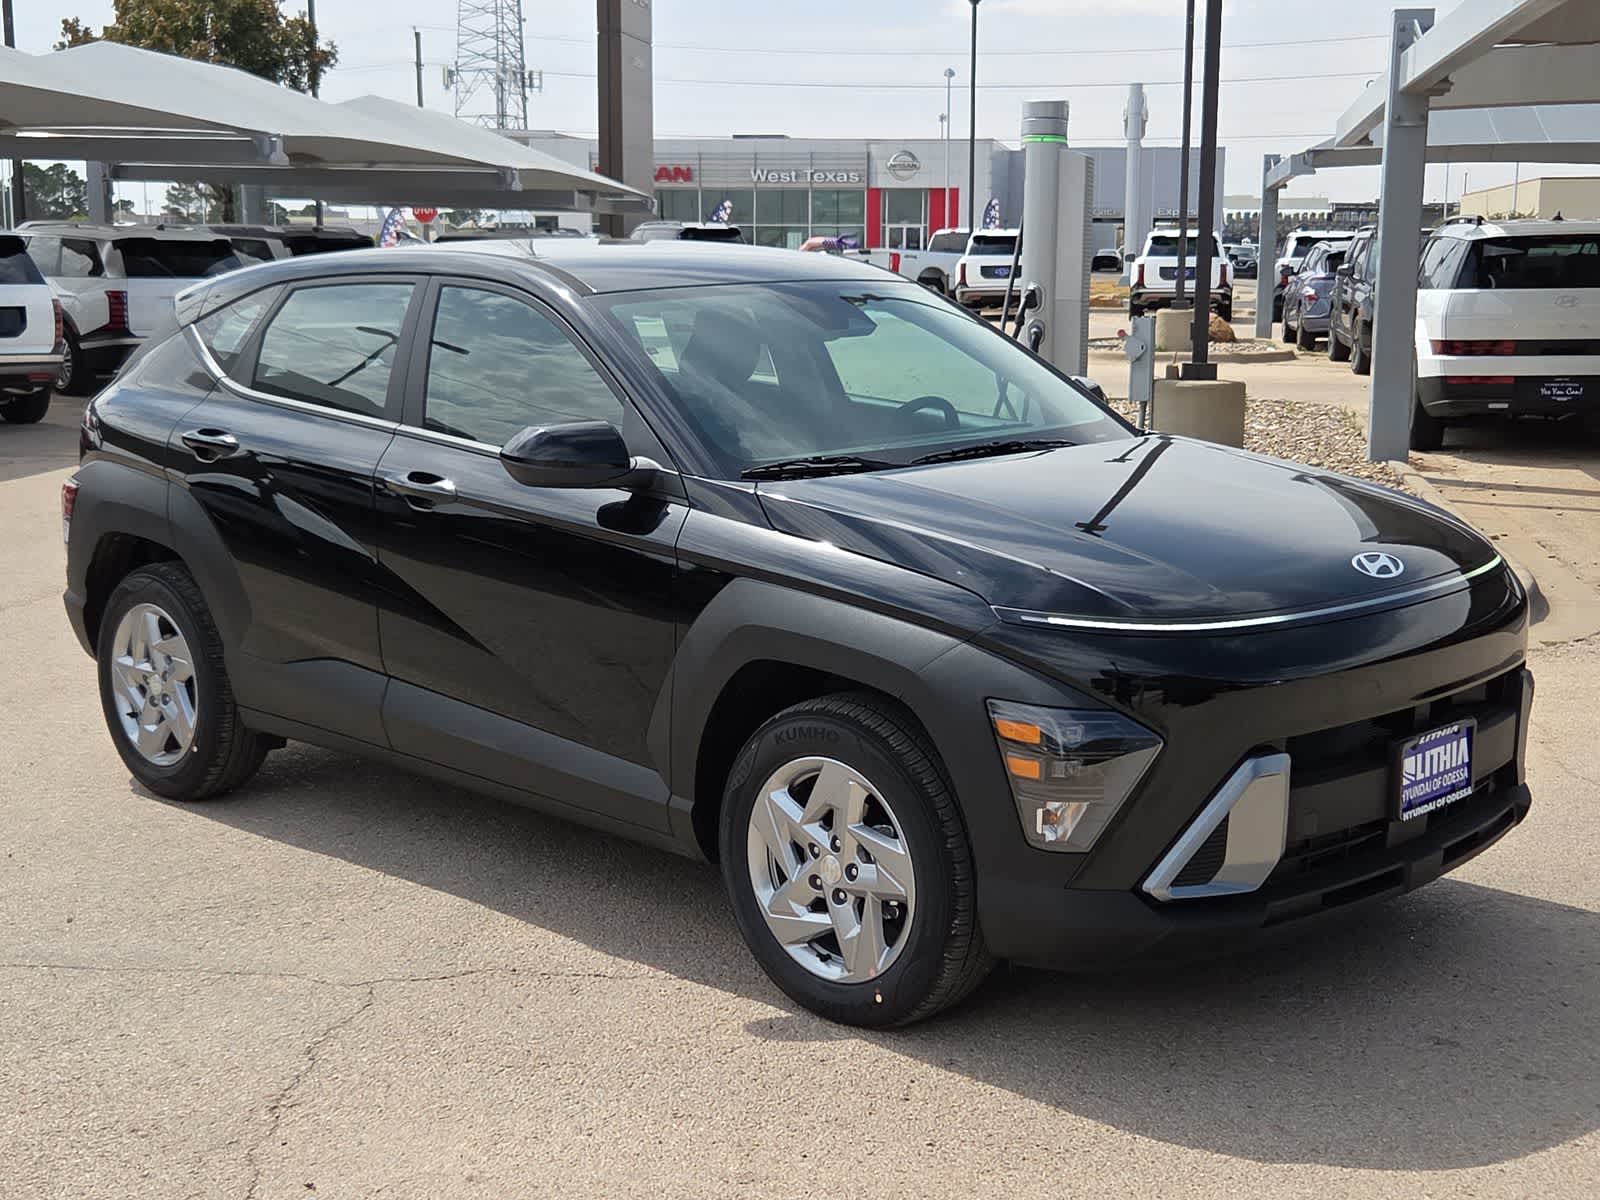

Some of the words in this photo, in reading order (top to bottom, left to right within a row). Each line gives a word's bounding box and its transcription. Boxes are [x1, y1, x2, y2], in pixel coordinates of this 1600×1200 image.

[750, 168, 796, 182] West
[804, 168, 860, 182] Texas
[774, 726, 840, 745] KUMHO
[1419, 725, 1459, 744] LITHIA
[1415, 736, 1470, 781] LITHIA
[1432, 776, 1442, 791] OF
[1442, 766, 1469, 786] ODESSA
[1436, 797, 1446, 808] OF
